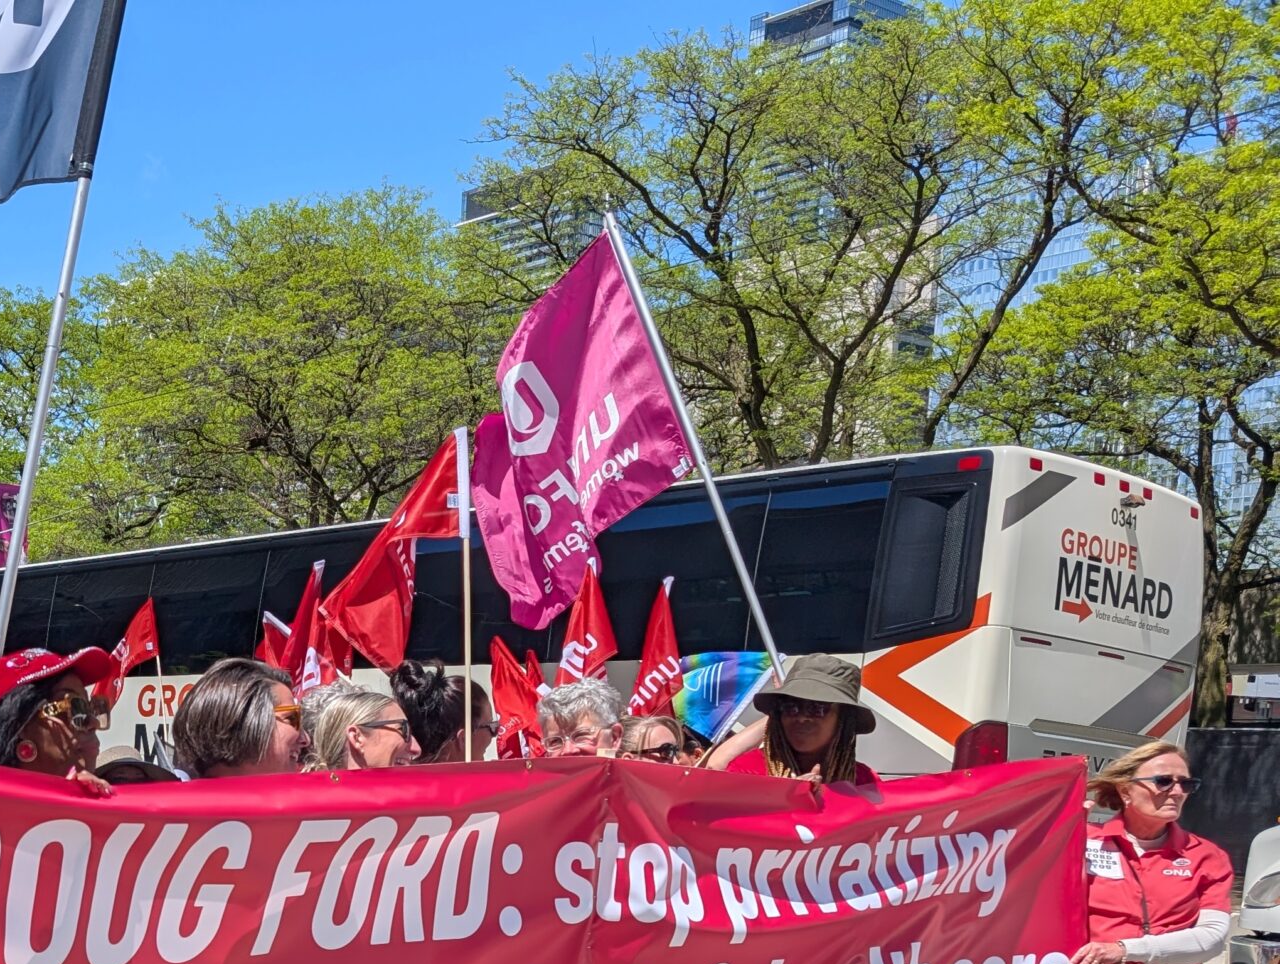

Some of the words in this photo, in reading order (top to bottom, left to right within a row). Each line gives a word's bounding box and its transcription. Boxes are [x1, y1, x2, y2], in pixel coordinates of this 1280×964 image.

[1111, 507, 1137, 531] 0341
[1061, 528, 1138, 571] GROUPE
[1095, 609, 1111, 622] Votre
[1111, 613, 1137, 629] chauffeur
[1146, 619, 1170, 636] confiance
[250, 811, 523, 957] FORD:
[554, 822, 705, 948] stop
[716, 811, 1017, 945] privatizing
[1162, 869, 1193, 878] ONA
